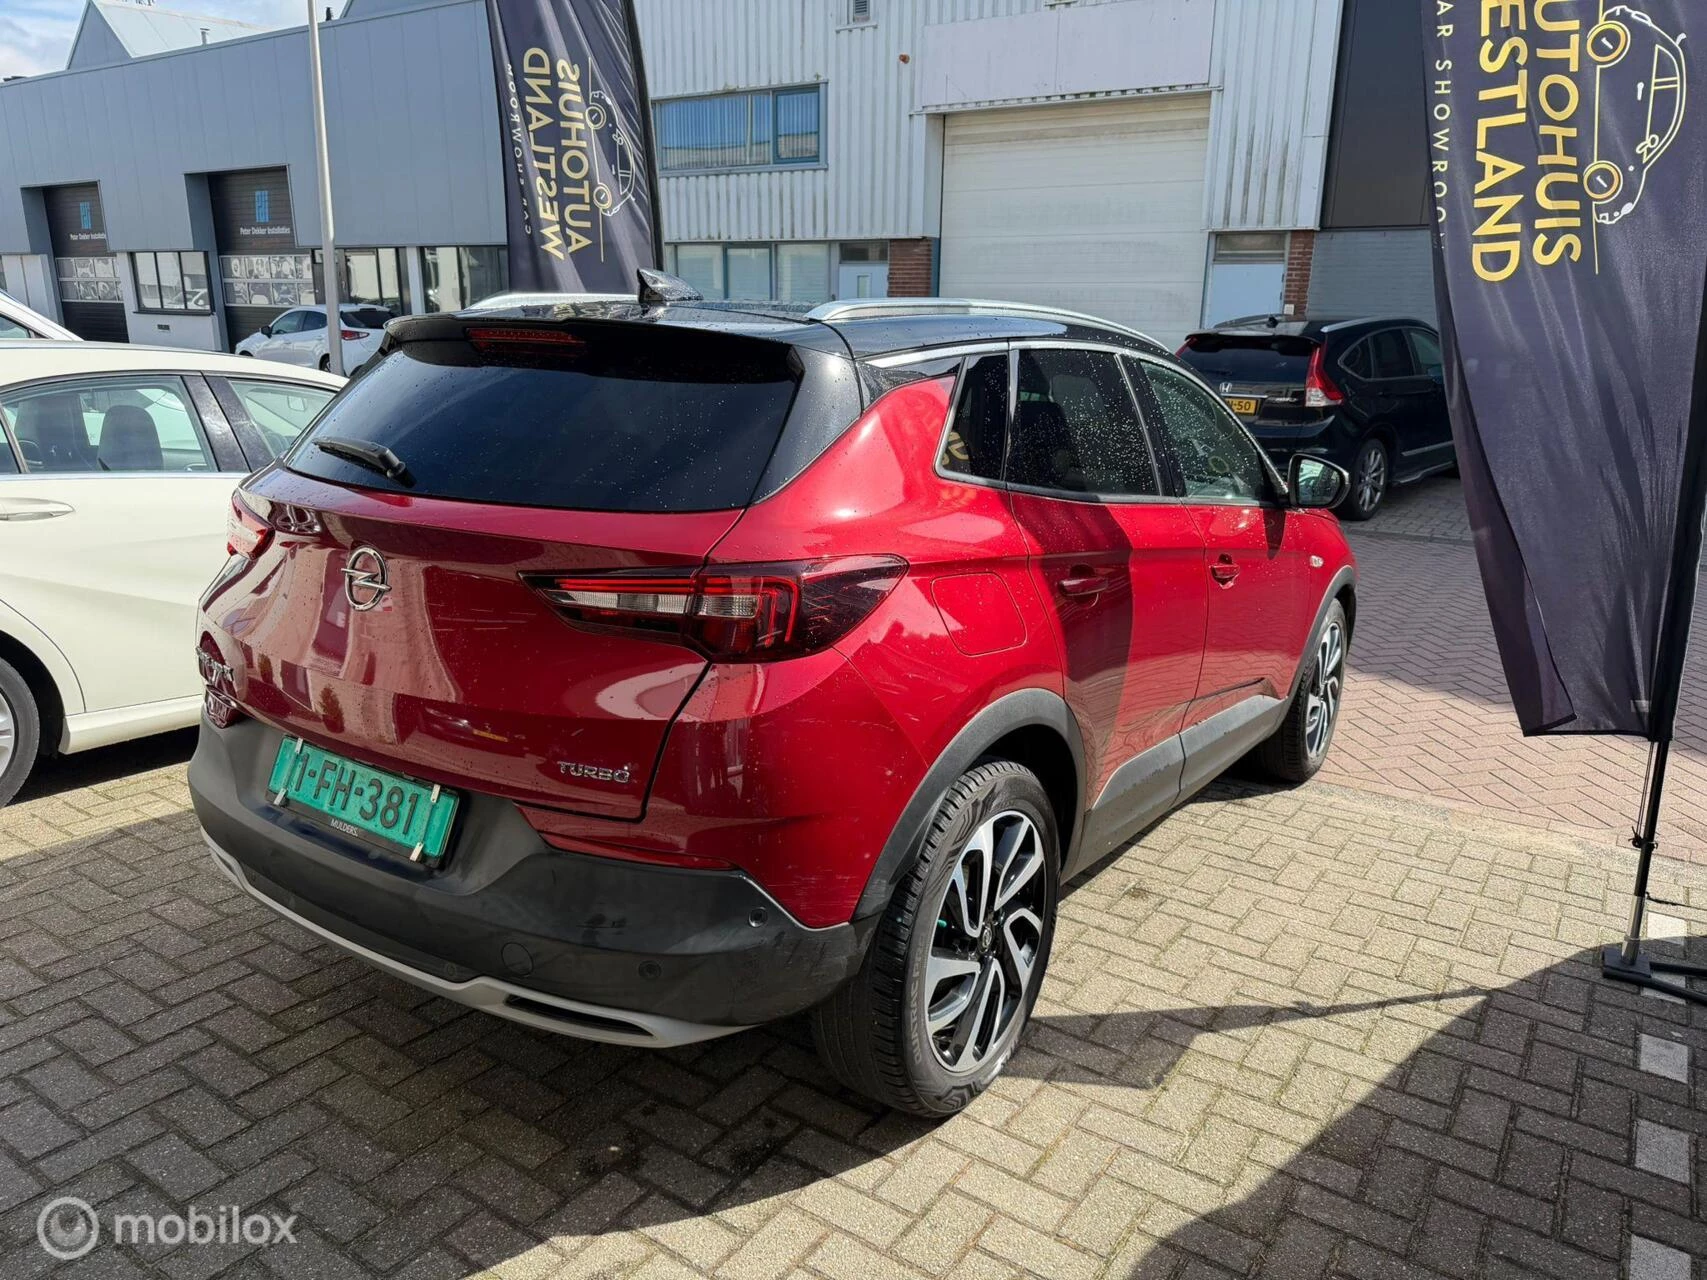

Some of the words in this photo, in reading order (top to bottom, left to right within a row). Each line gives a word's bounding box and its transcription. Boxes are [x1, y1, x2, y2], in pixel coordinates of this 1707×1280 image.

[1436, 0, 1454, 38] AR
[1532, 0, 1582, 266] UTOHUIS
[1431, 59, 1453, 250] SHOWROO
[1471, 0, 1529, 282] ESTLAND
